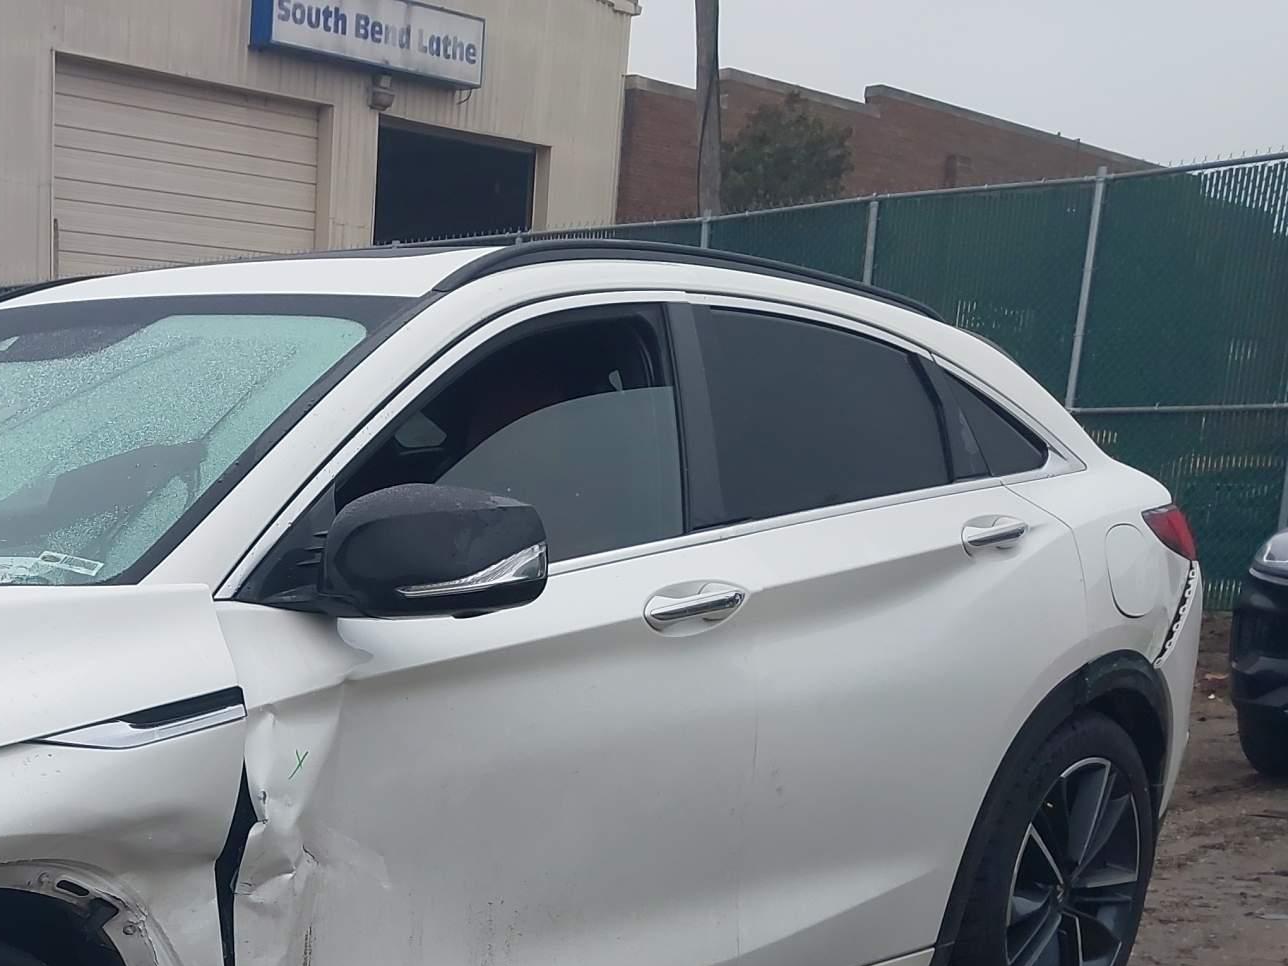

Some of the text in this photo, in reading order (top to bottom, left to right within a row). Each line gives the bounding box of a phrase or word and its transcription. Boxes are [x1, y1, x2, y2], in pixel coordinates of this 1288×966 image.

[277, 0, 477, 65] South Bend Lathe
